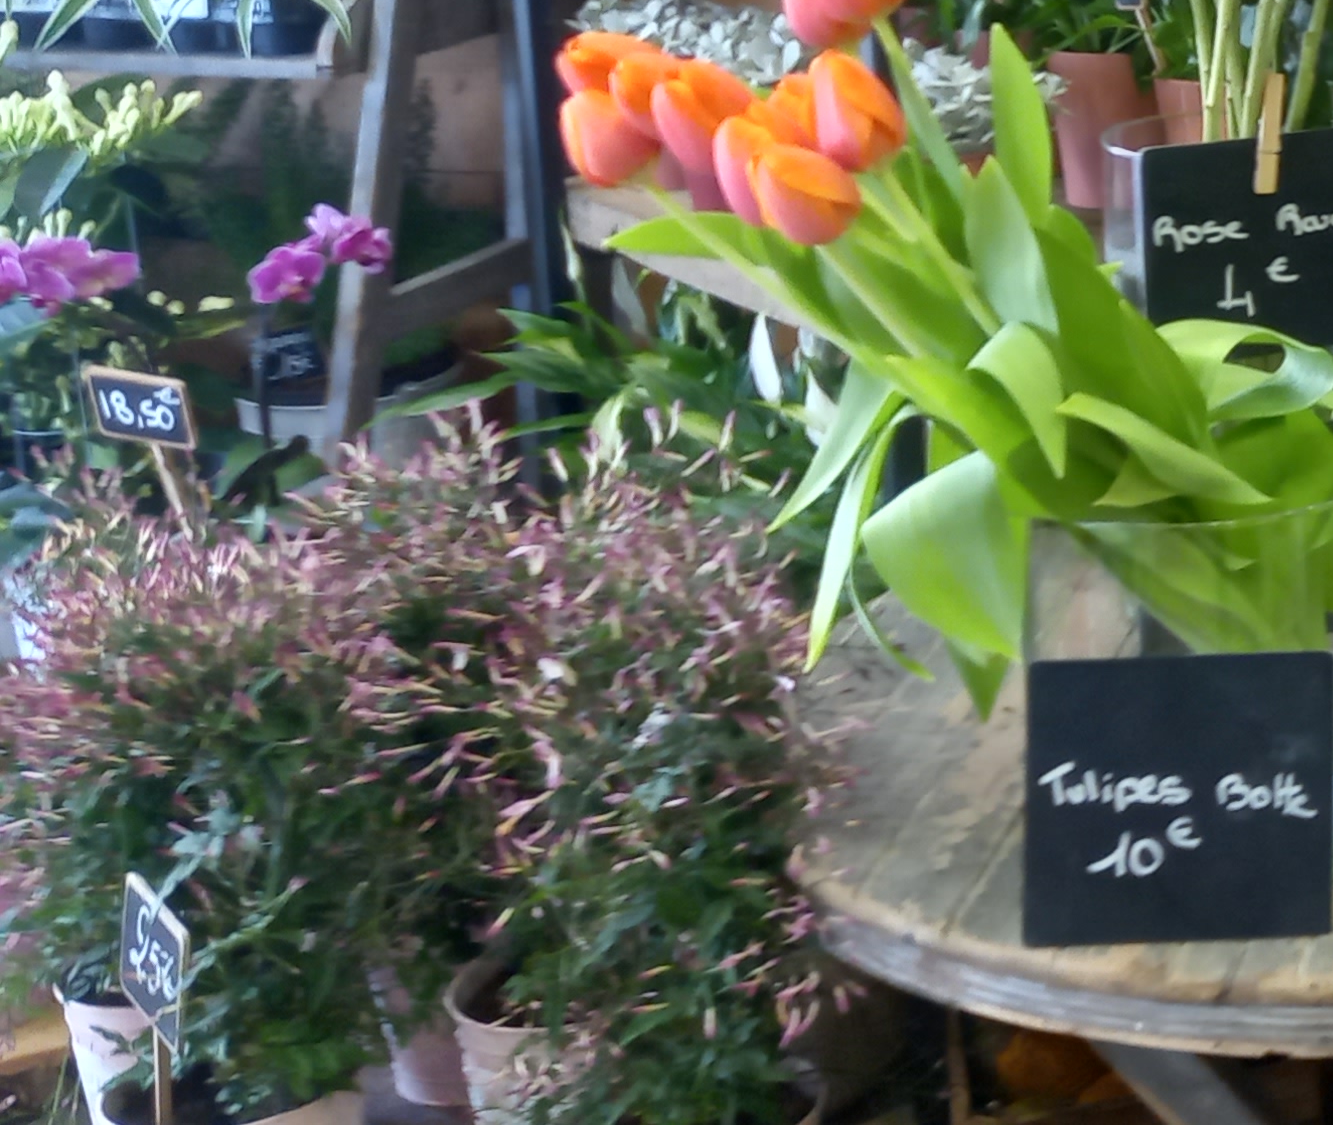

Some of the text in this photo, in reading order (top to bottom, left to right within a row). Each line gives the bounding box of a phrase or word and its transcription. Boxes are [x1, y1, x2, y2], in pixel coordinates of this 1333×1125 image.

[1153, 215, 1249, 253] Rose
[1037, 760, 1319, 819] Tulipes Botte
